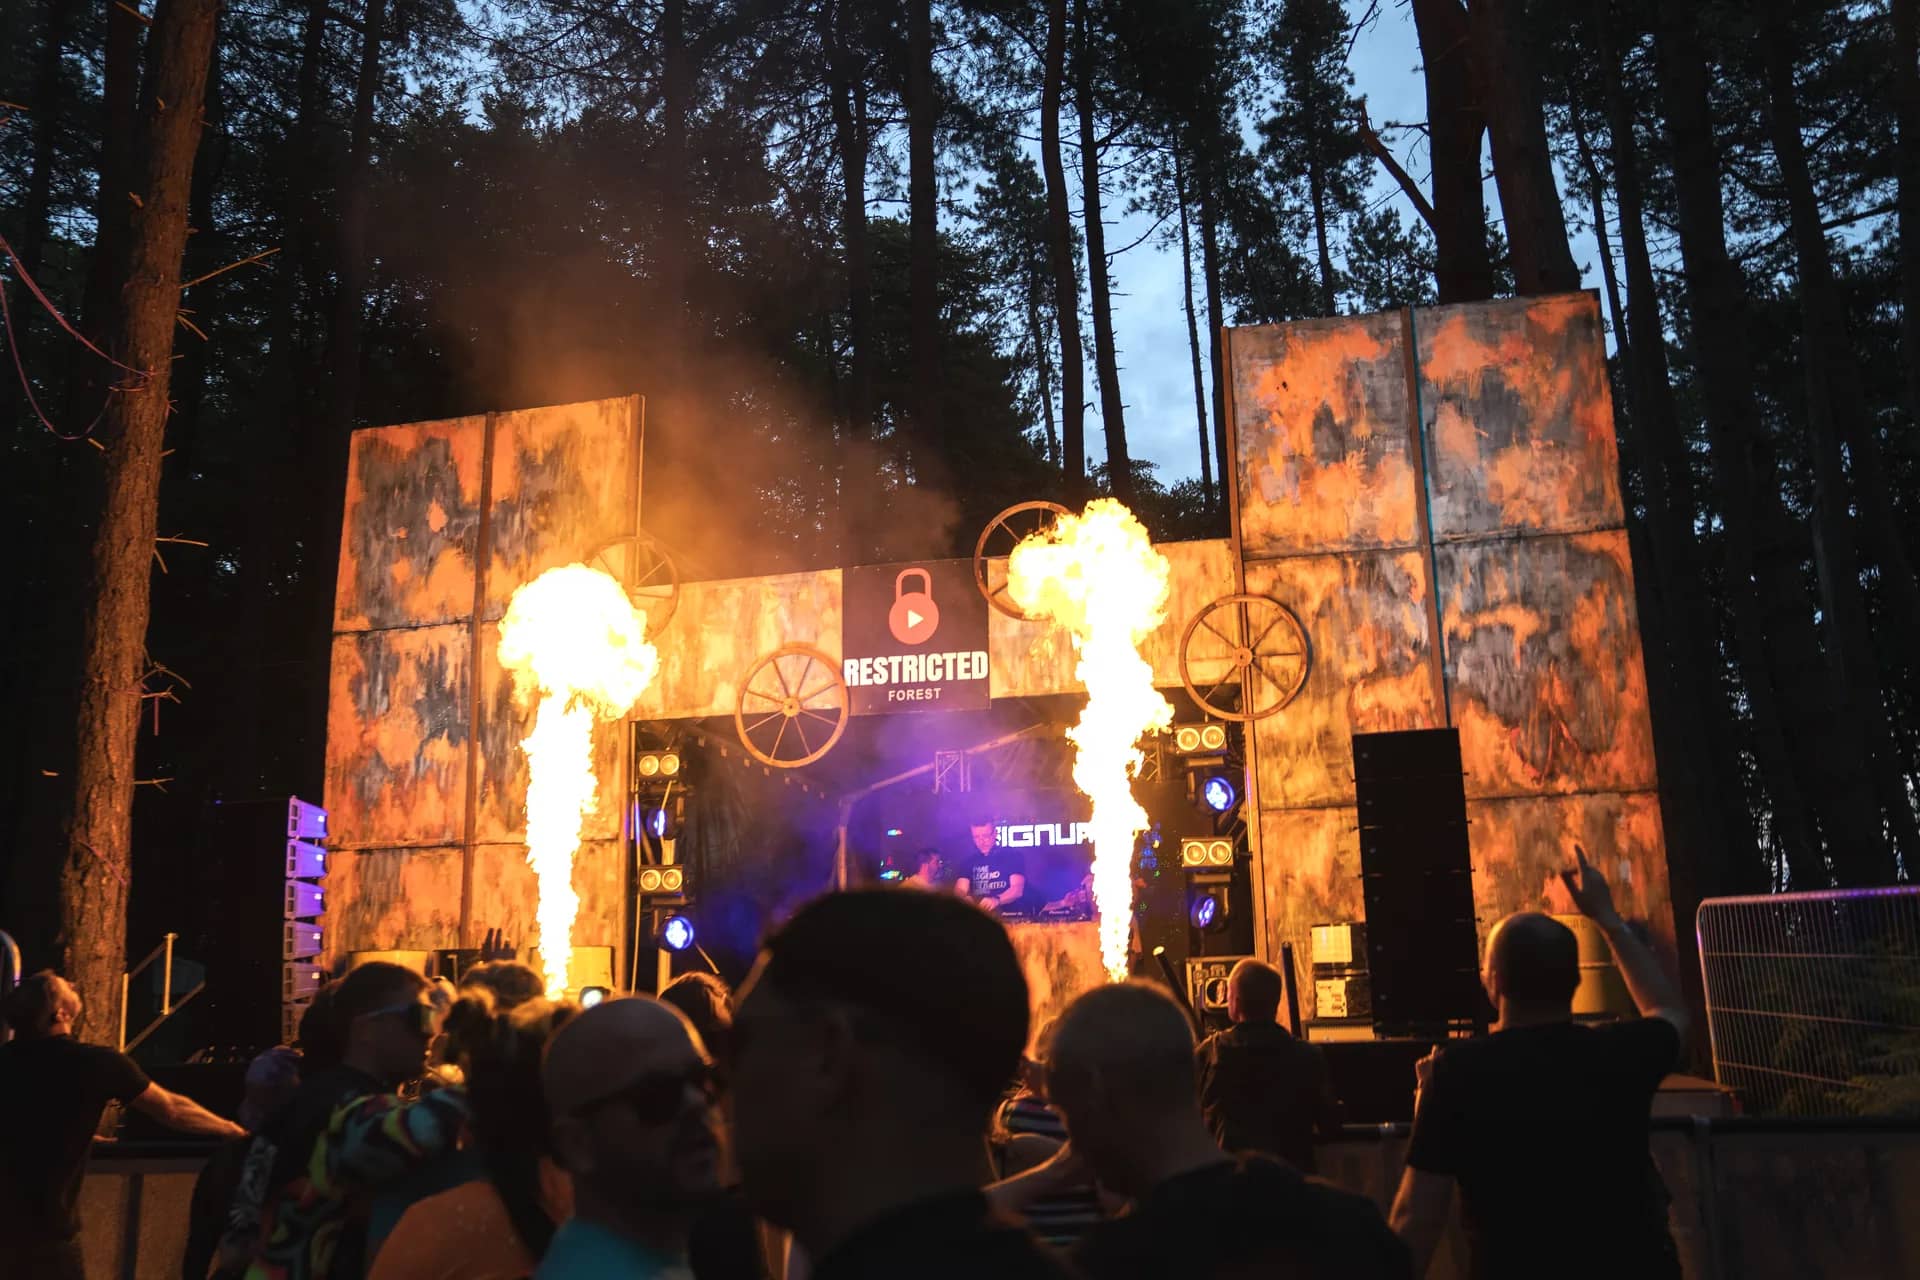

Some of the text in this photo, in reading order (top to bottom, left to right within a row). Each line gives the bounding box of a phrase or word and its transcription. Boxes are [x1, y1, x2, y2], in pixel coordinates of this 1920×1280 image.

[843, 651, 988, 687] RESTRICTED
[888, 687, 942, 702] FOREST
[995, 822, 1096, 848] IGNU
